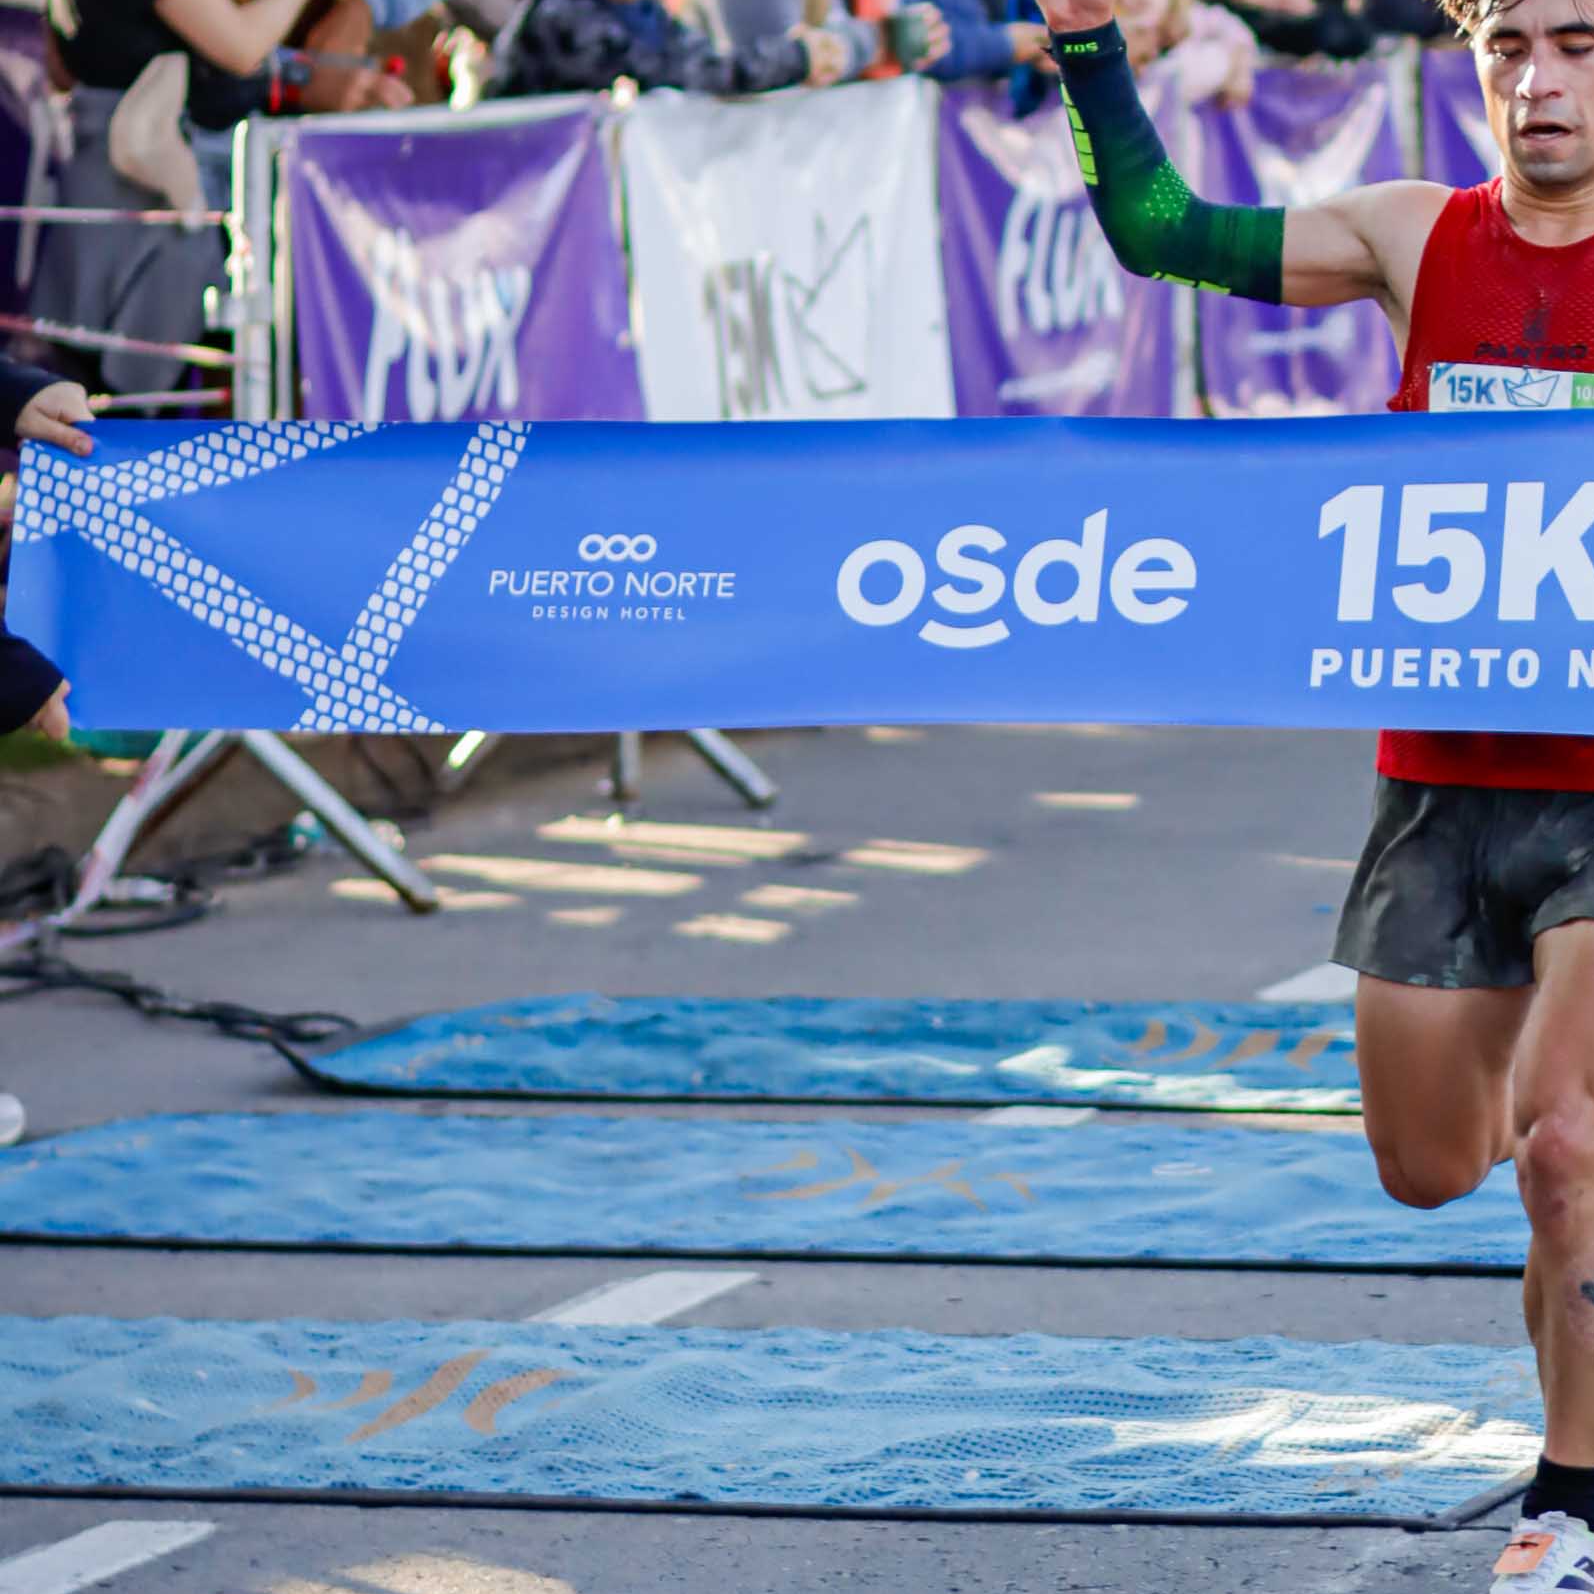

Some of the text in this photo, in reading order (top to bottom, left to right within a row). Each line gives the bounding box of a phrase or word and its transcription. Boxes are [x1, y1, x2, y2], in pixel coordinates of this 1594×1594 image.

[1446, 374, 1497, 404] 15K
[488, 569, 737, 598] PUERTO NORTE
[836, 507, 1198, 648] osde
[531, 605, 687, 622] DESIGN HOTEL
[1309, 648, 1540, 688] PUERTO
